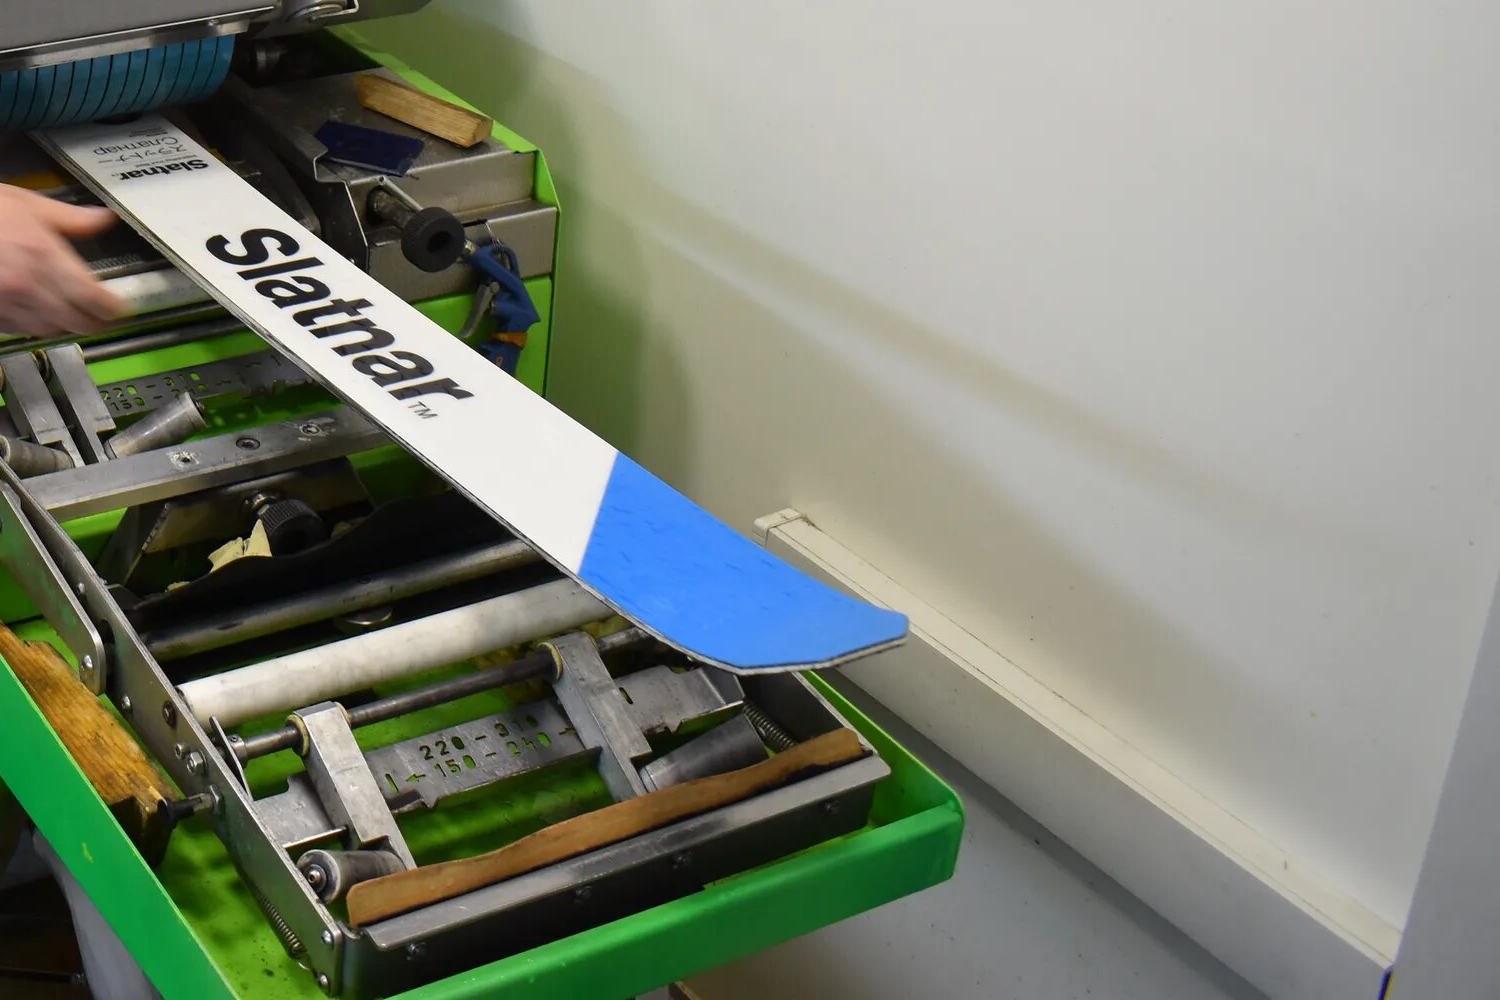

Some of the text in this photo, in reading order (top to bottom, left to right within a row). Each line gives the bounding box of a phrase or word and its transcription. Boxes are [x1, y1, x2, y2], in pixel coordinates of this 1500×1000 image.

[93, 136, 179, 156] Слатнар
[97, 144, 188, 164] スラットナー
[120, 159, 209, 181] Slatnar
[205, 228, 475, 401] Slatnar
[419, 735, 465, 761] 220
[494, 714, 539, 738] 310
[434, 754, 476, 778] 150
